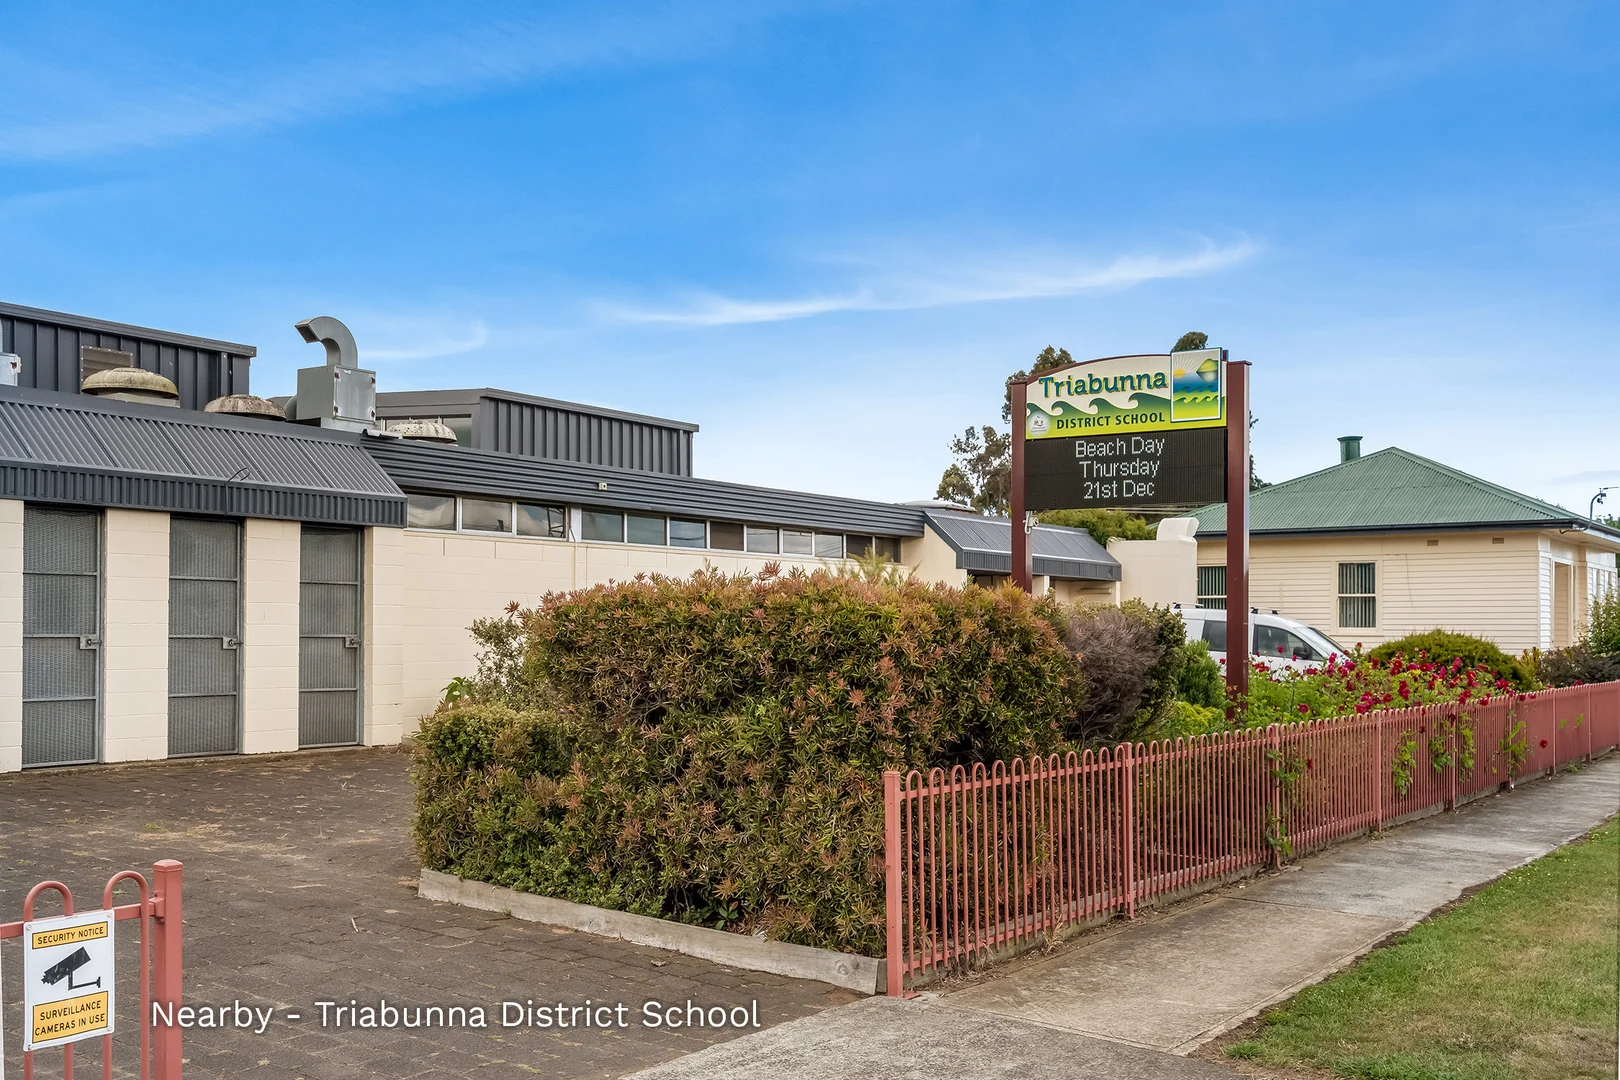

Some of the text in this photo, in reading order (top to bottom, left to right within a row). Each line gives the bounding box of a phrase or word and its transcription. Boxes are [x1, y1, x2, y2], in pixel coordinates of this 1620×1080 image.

[1039, 371, 1168, 398] Triabunna
[1056, 415, 1111, 430] DISTRICT
[1115, 411, 1165, 425] SCHOOL
[1075, 436, 1165, 458] Beach Day
[1079, 457, 1160, 479] Thursday
[1084, 479, 1155, 500] 21st Dec
[37, 926, 104, 945] SECURITY NOTICE
[40, 1000, 102, 1021] SURVEILLANCE
[34, 1013, 105, 1036] CAMERAS IN USE
